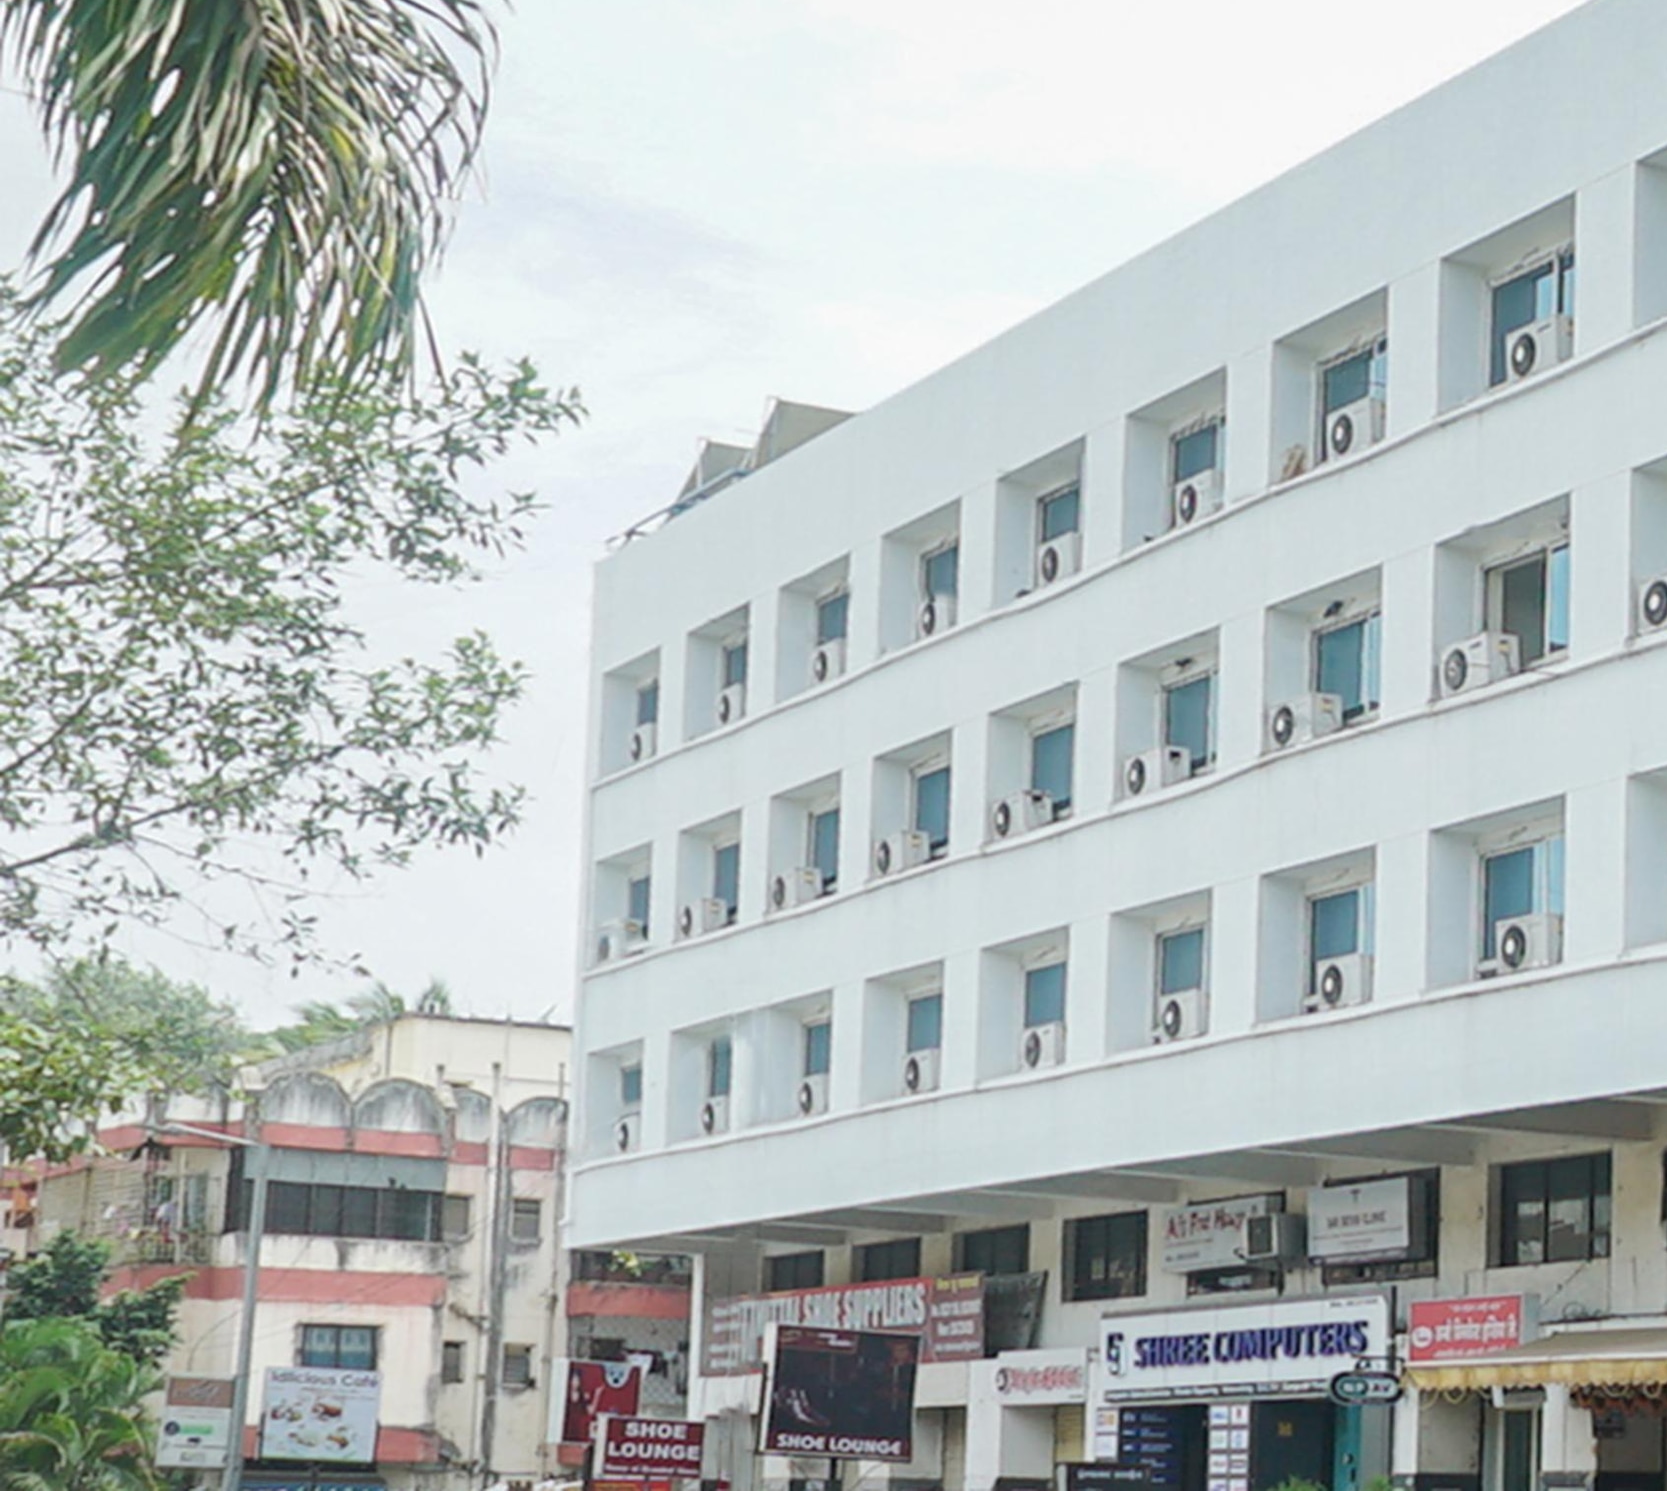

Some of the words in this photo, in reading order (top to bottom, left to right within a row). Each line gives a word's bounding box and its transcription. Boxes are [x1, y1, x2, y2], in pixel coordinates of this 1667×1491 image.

[842, 1283, 925, 1329] SUPPLIERS
[1134, 1332, 1211, 1369] SHREE
[1213, 1320, 1369, 1363] COMPUTERS
[625, 1421, 687, 1440] SHOE
[607, 1441, 701, 1462] LOUNGE
[777, 1432, 826, 1451] SHOE
[829, 1436, 901, 1455] LOUNGE
